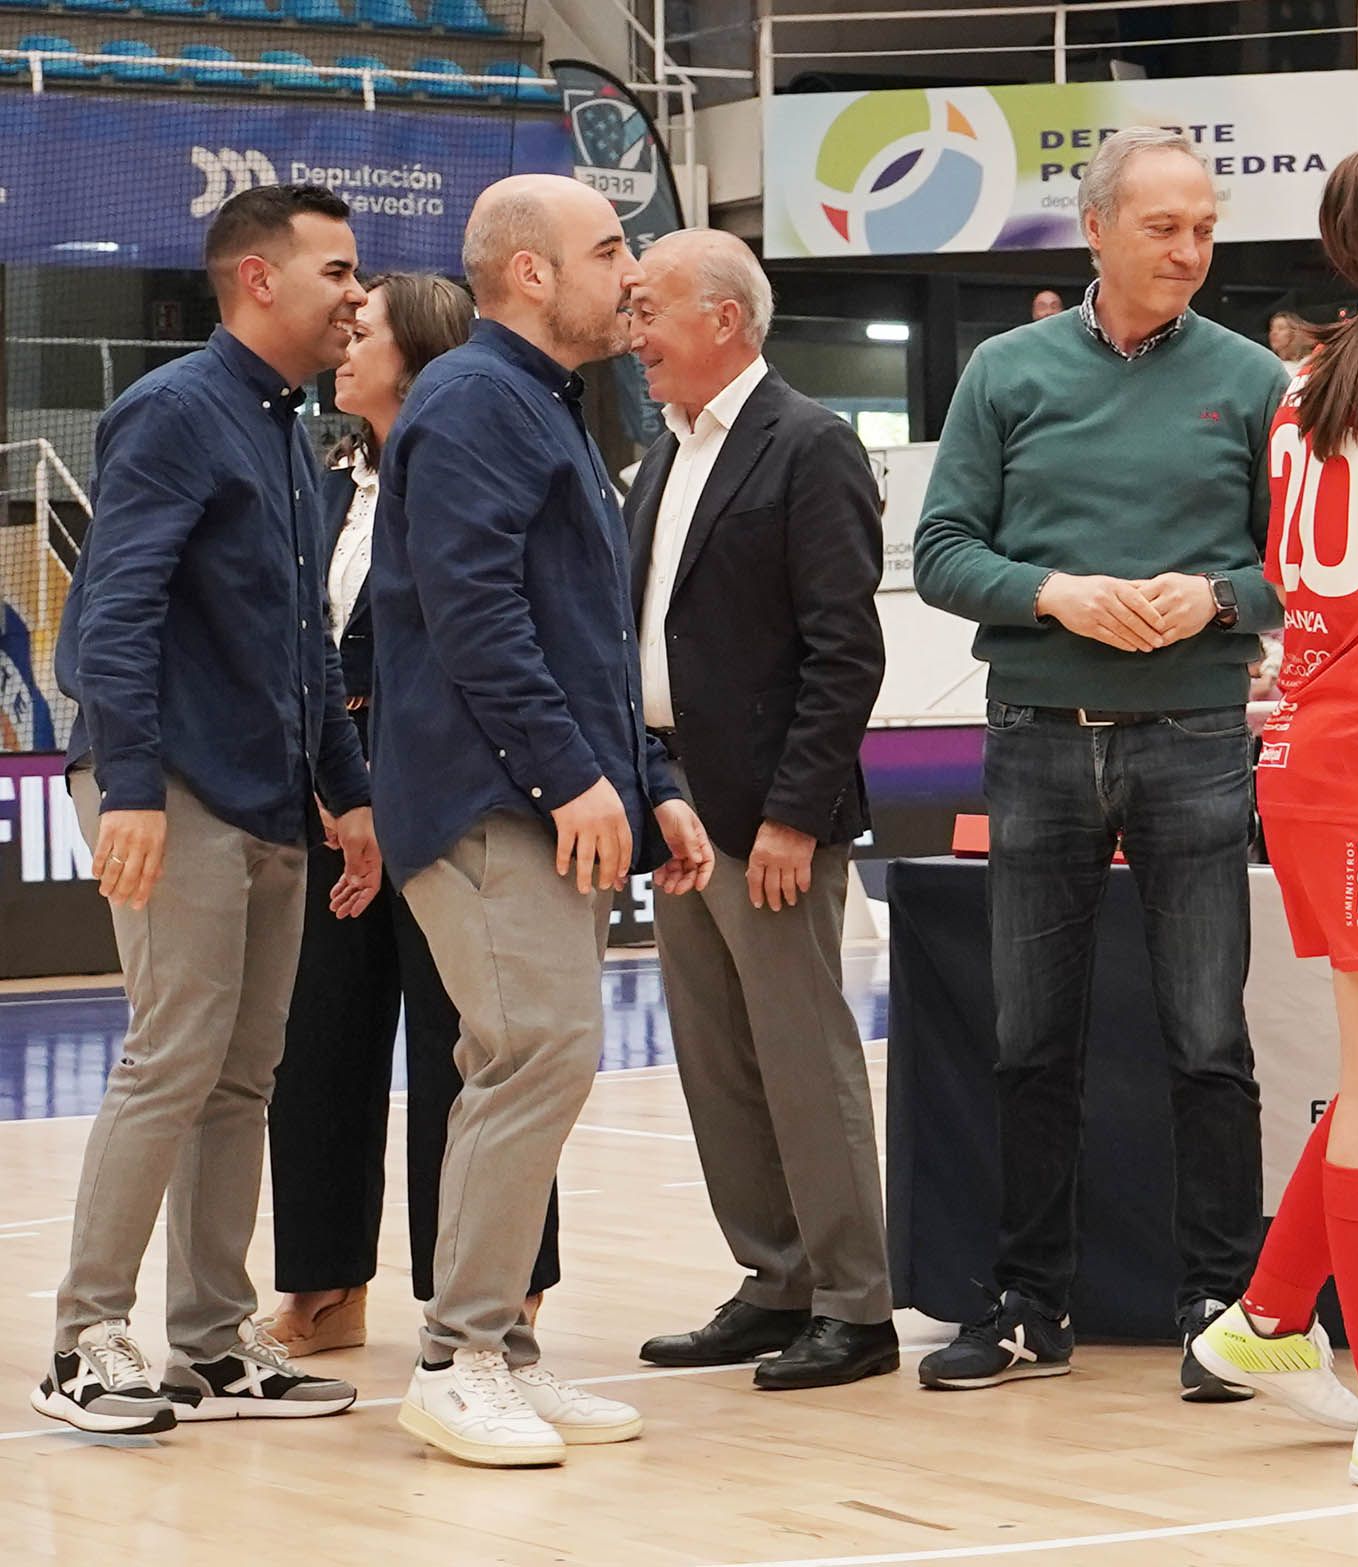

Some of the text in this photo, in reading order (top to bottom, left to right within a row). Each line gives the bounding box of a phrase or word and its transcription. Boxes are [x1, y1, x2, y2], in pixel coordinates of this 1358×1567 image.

[1040, 123, 1236, 150] DEPTE
[290, 161, 443, 192] Deputación
[1041, 153, 1327, 182] POEDRA
[340, 190, 445, 216] tevedra
[1284, 609, 1329, 635] ANCA
[1345, 841, 1356, 927] SUMINISTROS
